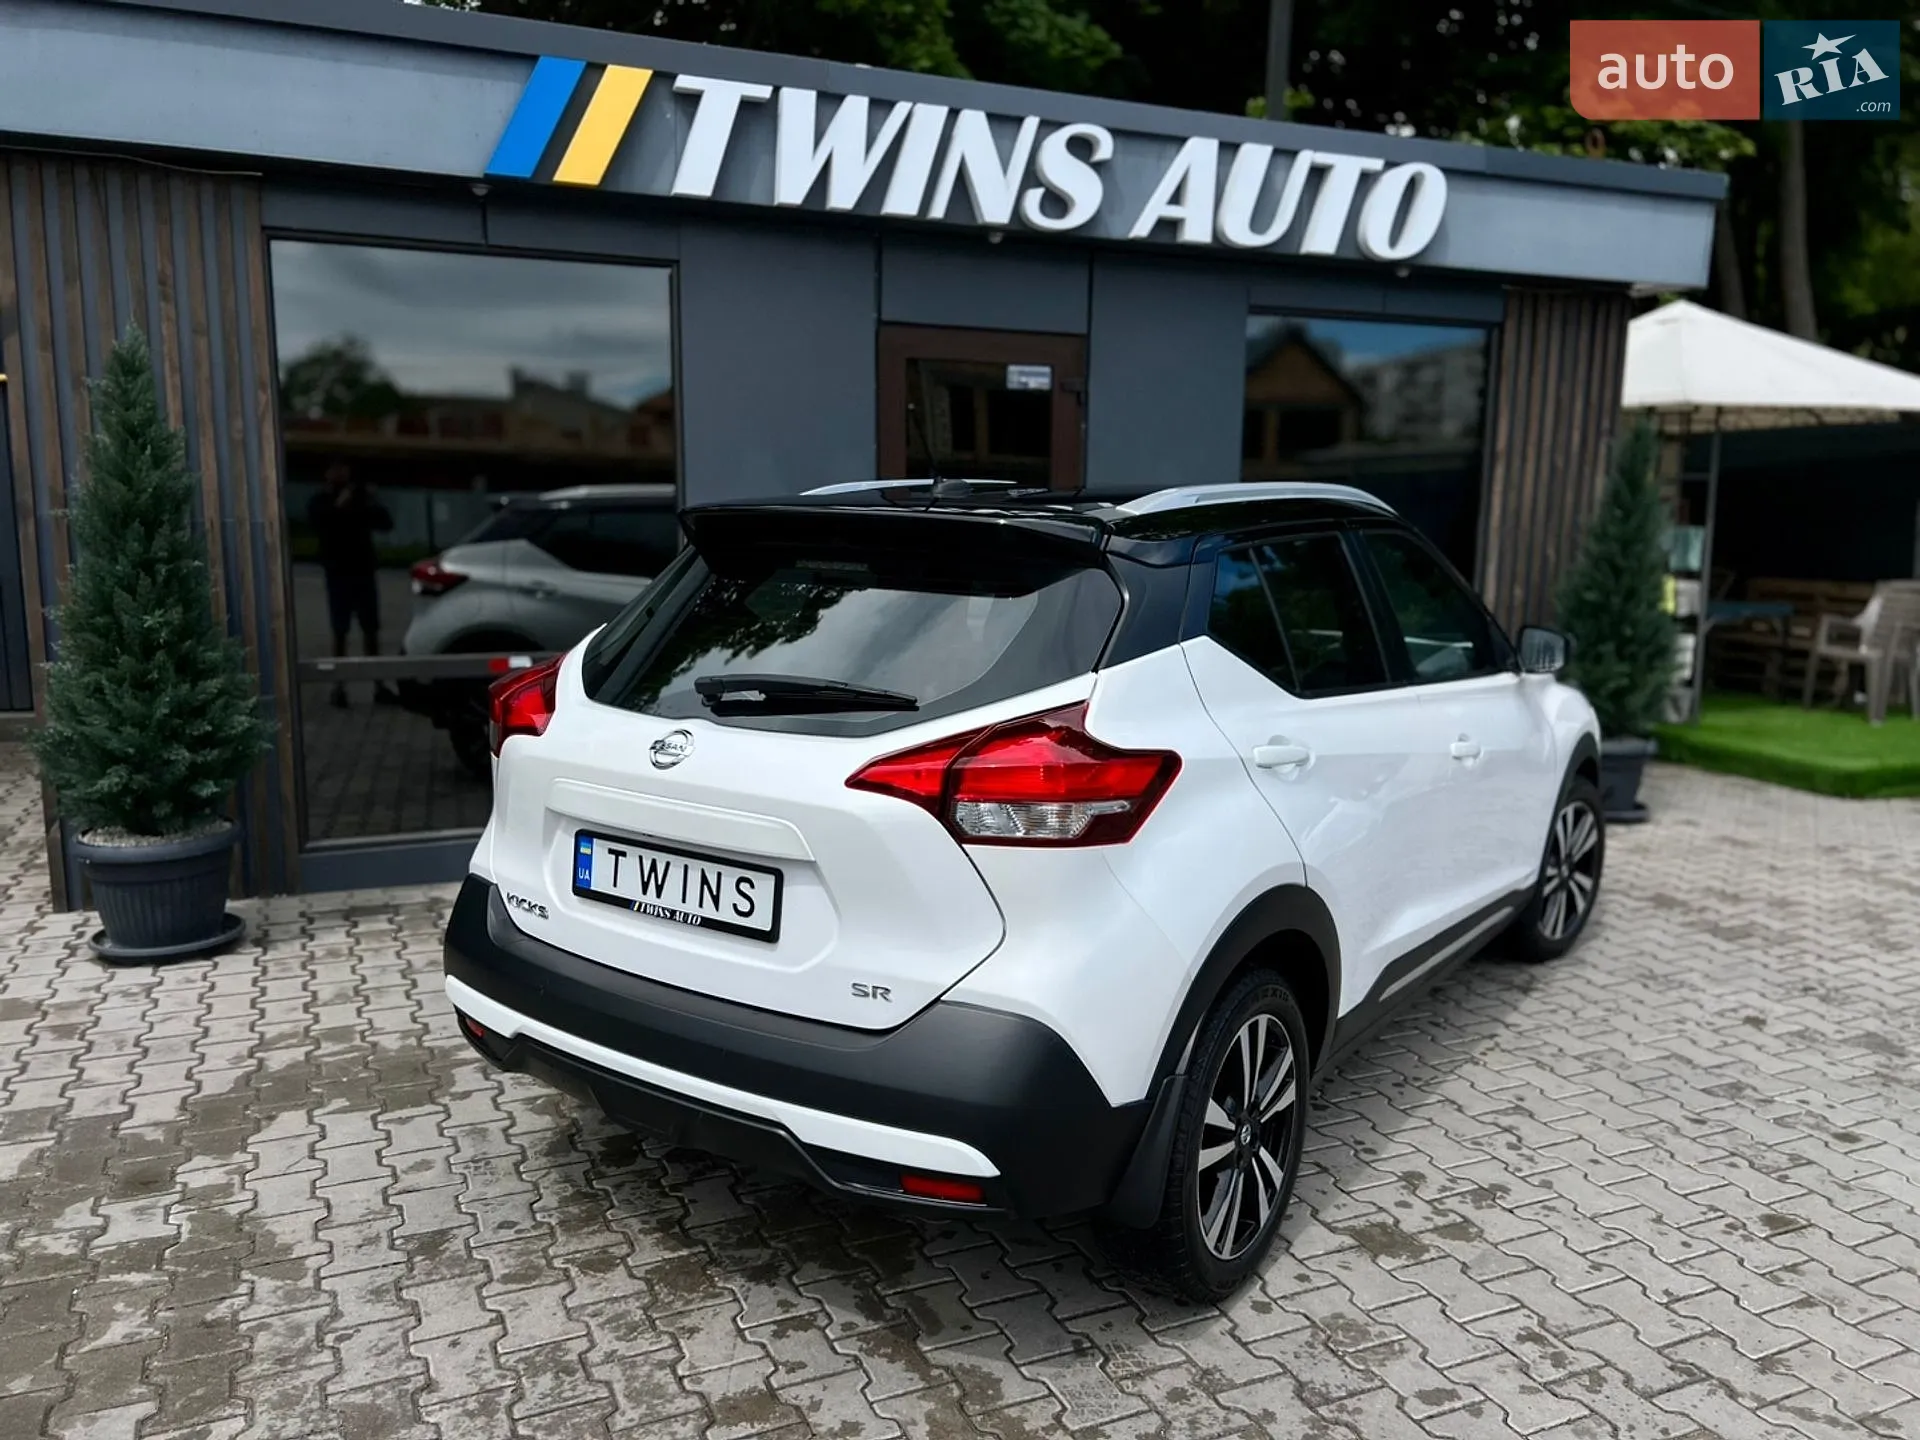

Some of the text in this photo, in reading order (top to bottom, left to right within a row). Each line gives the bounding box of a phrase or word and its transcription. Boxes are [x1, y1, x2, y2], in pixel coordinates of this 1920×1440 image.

[671, 73, 1448, 261] TWINS AUTO
[578, 867, 591, 881] UA
[607, 847, 757, 919] TWINS
[506, 891, 549, 920] KICKS
[640, 901, 702, 926] TWINS AUTO
[851, 982, 893, 1003] SR
